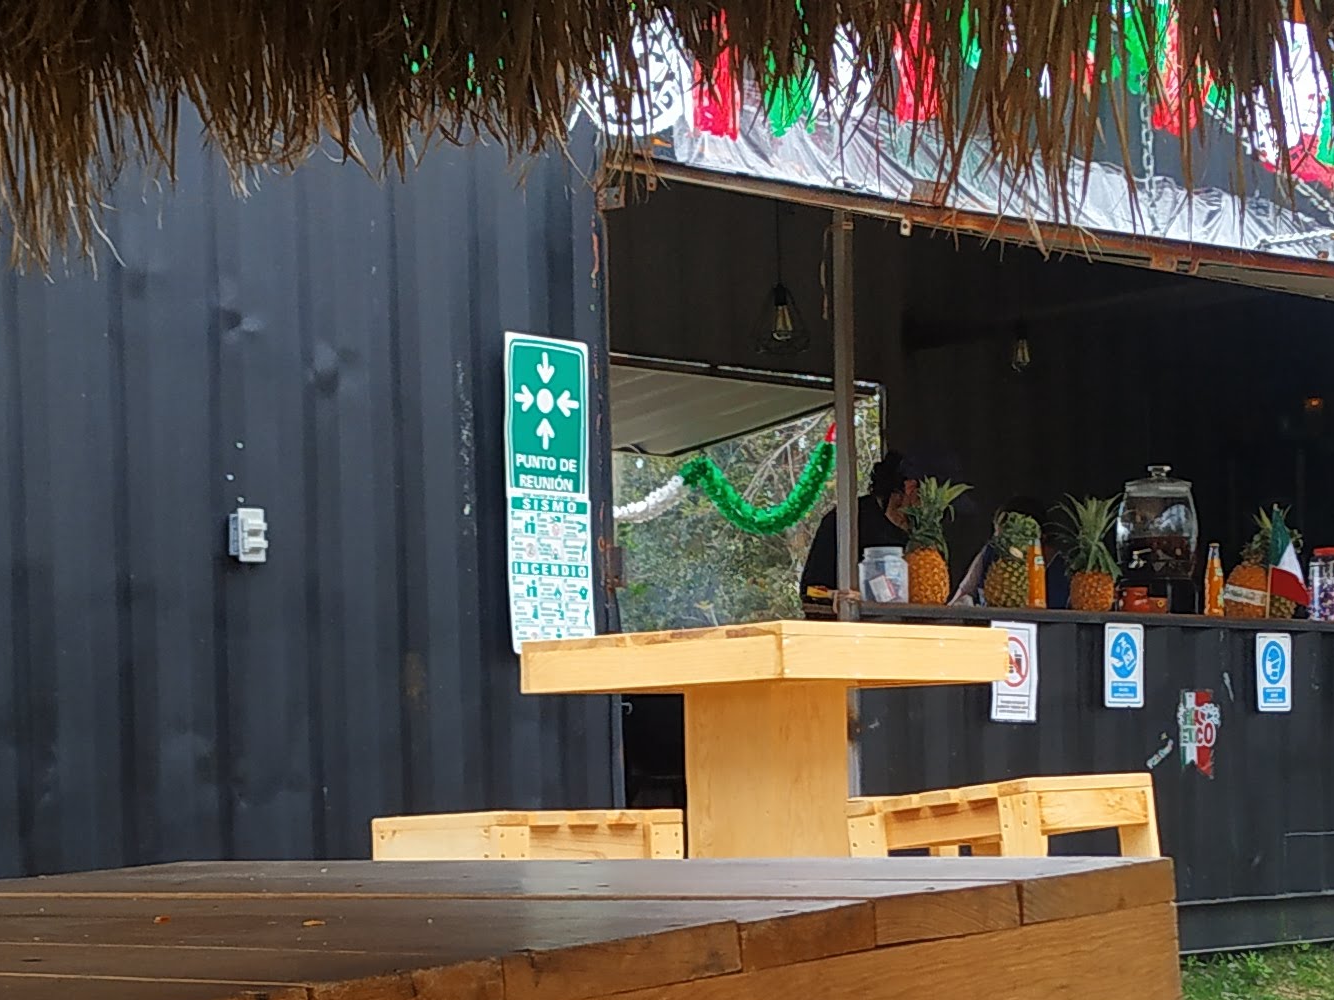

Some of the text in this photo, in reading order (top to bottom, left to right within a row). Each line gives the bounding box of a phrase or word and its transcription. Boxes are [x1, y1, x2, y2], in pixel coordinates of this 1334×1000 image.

[515, 453, 578, 473] PUNTO DE
[518, 473, 574, 492] REUNIÓN
[521, 498, 577, 513] SISMO
[514, 562, 587, 577] INCENDIO
